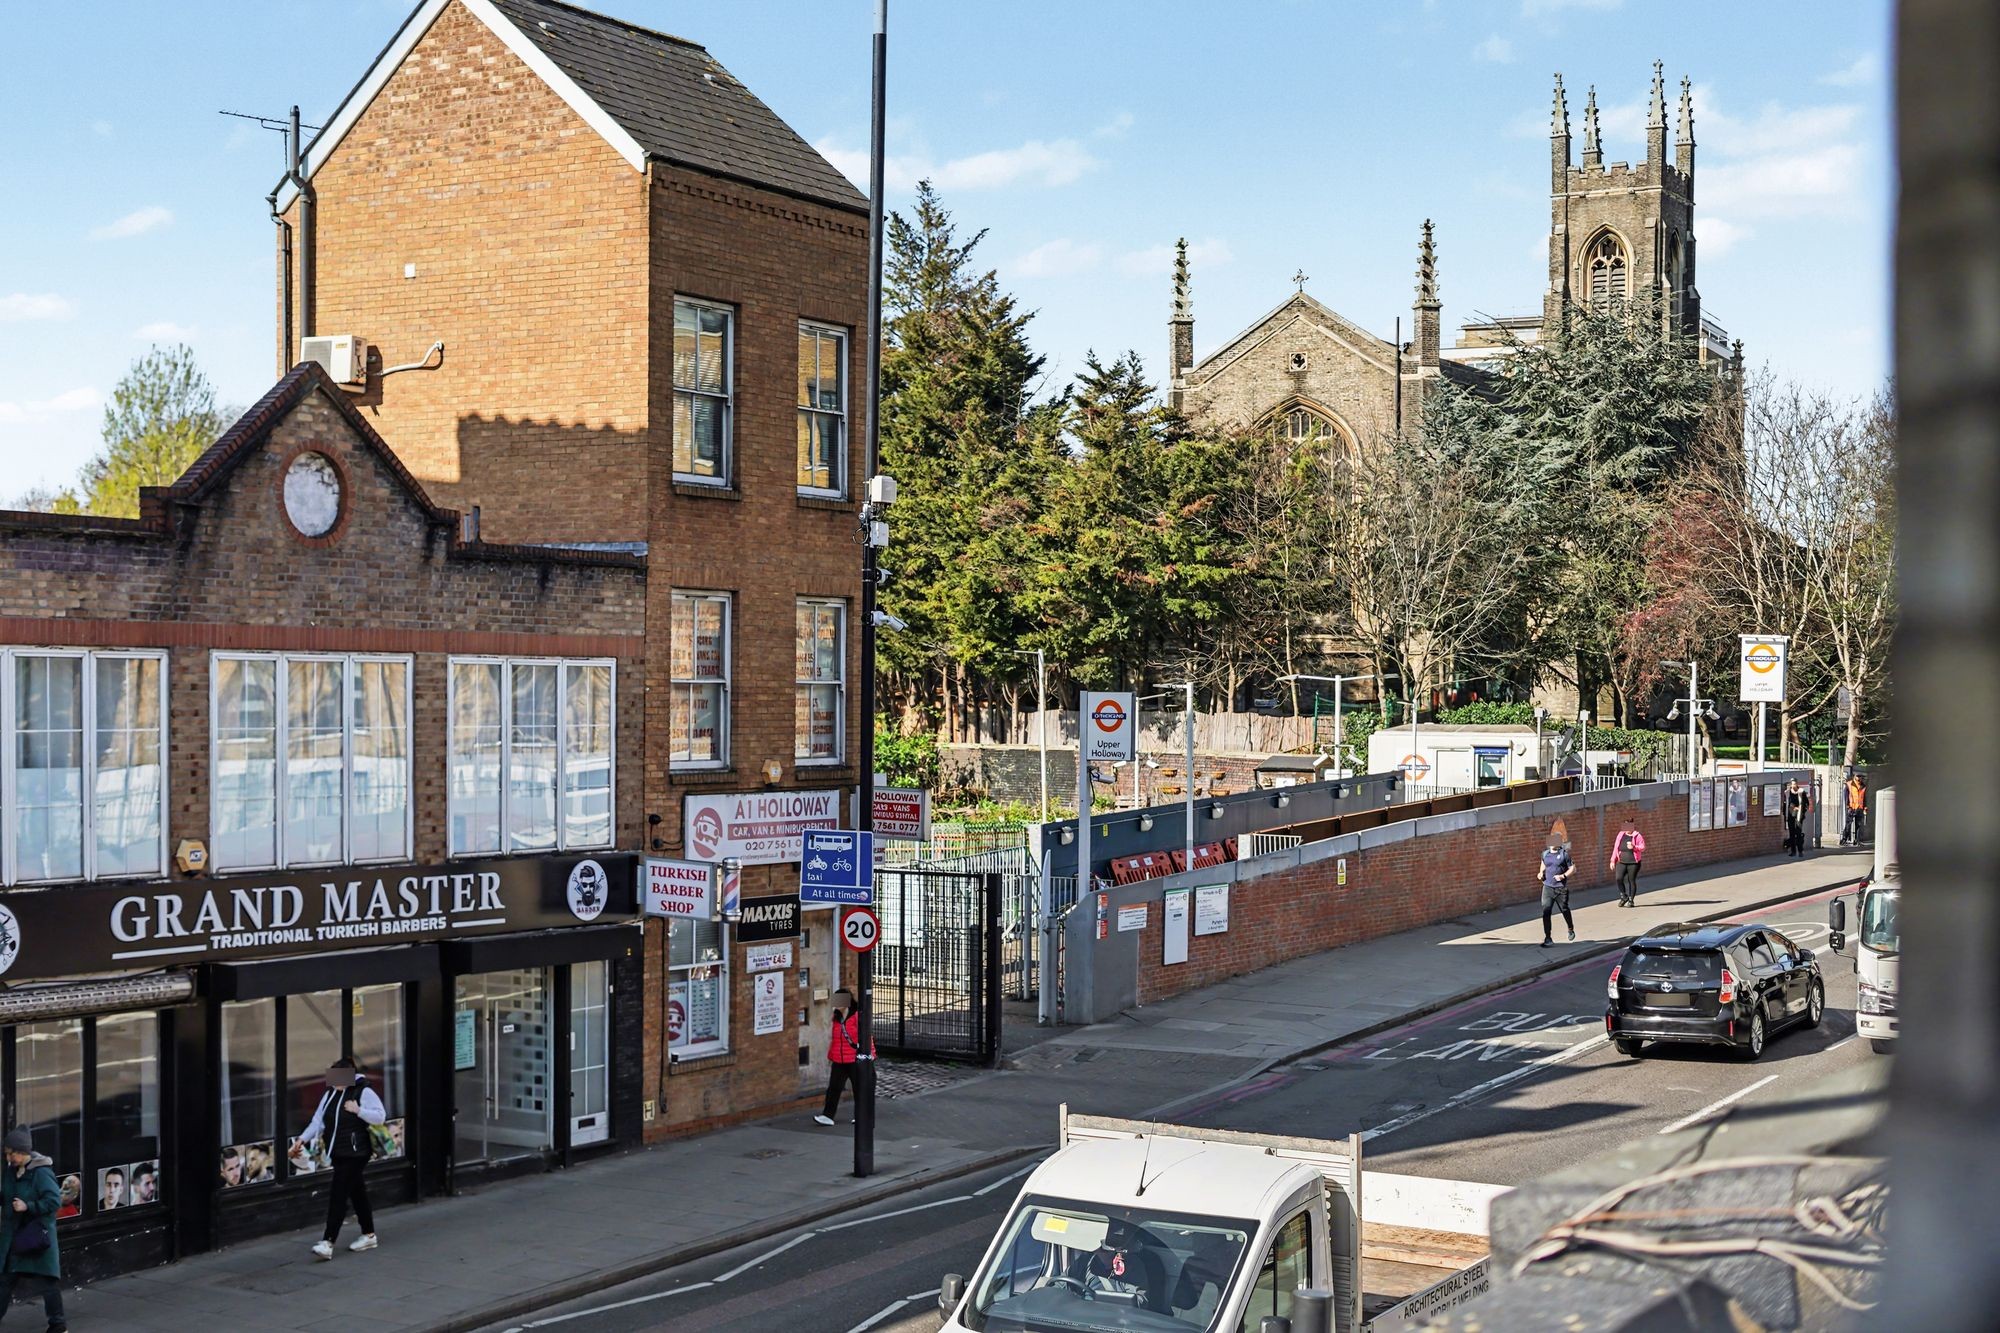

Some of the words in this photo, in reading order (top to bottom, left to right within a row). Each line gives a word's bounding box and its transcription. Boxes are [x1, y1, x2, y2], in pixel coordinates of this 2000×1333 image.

[1097, 740, 1120, 749] Upper
[1091, 750, 1126, 759] Holloway
[874, 792, 919, 802] HOLLOWAY
[757, 796, 831, 819] HOLLOWAY
[893, 804, 911, 812] VANS
[751, 825, 768, 836] VAN
[877, 821, 896, 830] 7561
[899, 824, 919, 832] 0777
[745, 841, 765, 851] 020
[767, 839, 791, 849] 7561
[650, 865, 707, 881] TURKISH
[807, 872, 823, 881] taxi
[652, 882, 704, 899] BARBER
[812, 889, 822, 898] At
[824, 890, 835, 899] all
[838, 890, 861, 900] times
[110, 885, 304, 942] GRAND
[320, 871, 506, 924] MASTER
[660, 899, 694, 914] SHOP
[742, 903, 794, 924] MAXXIS
[770, 919, 793, 931] TYRES
[847, 920, 875, 939] 20
[210, 926, 313, 950] TRADITIONAL
[316, 920, 378, 941] TURKISH
[381, 916, 447, 936] BARBERS
[1459, 1011, 1606, 1032] BUS
[1404, 1278, 1463, 1319] ARCHITECTURAL
[1463, 1264, 1485, 1286] STEEL
